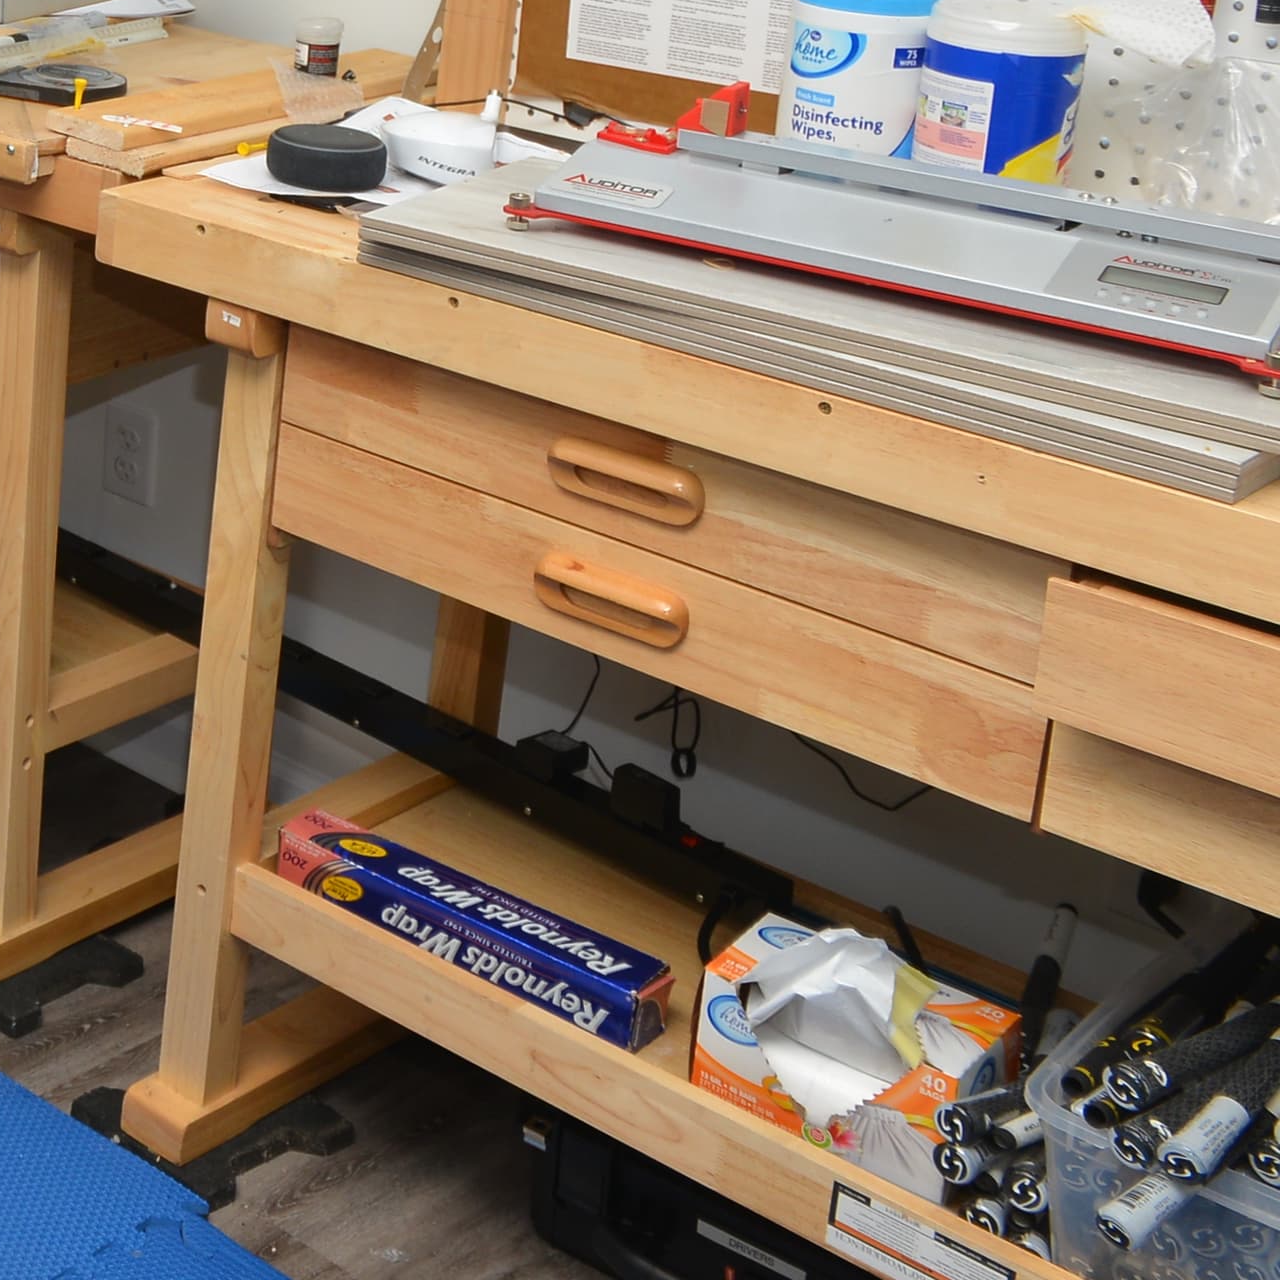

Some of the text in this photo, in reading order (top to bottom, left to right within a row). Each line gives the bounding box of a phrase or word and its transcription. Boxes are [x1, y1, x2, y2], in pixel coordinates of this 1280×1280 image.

[792, 103, 884, 135] Disinfecting
[418, 155, 476, 177] INTEGRA
[282, 849, 309, 870] 200
[397, 865, 632, 976] Reynolds Wrap
[464, 928, 490, 947] SINCE
[493, 943, 533, 969] TRUSTED
[380, 903, 610, 1035] Reynolds Wrap
[919, 1086, 945, 1104] BAGS
[921, 1073, 947, 1093] 40
[728, 1236, 776, 1266] DRIVERS
